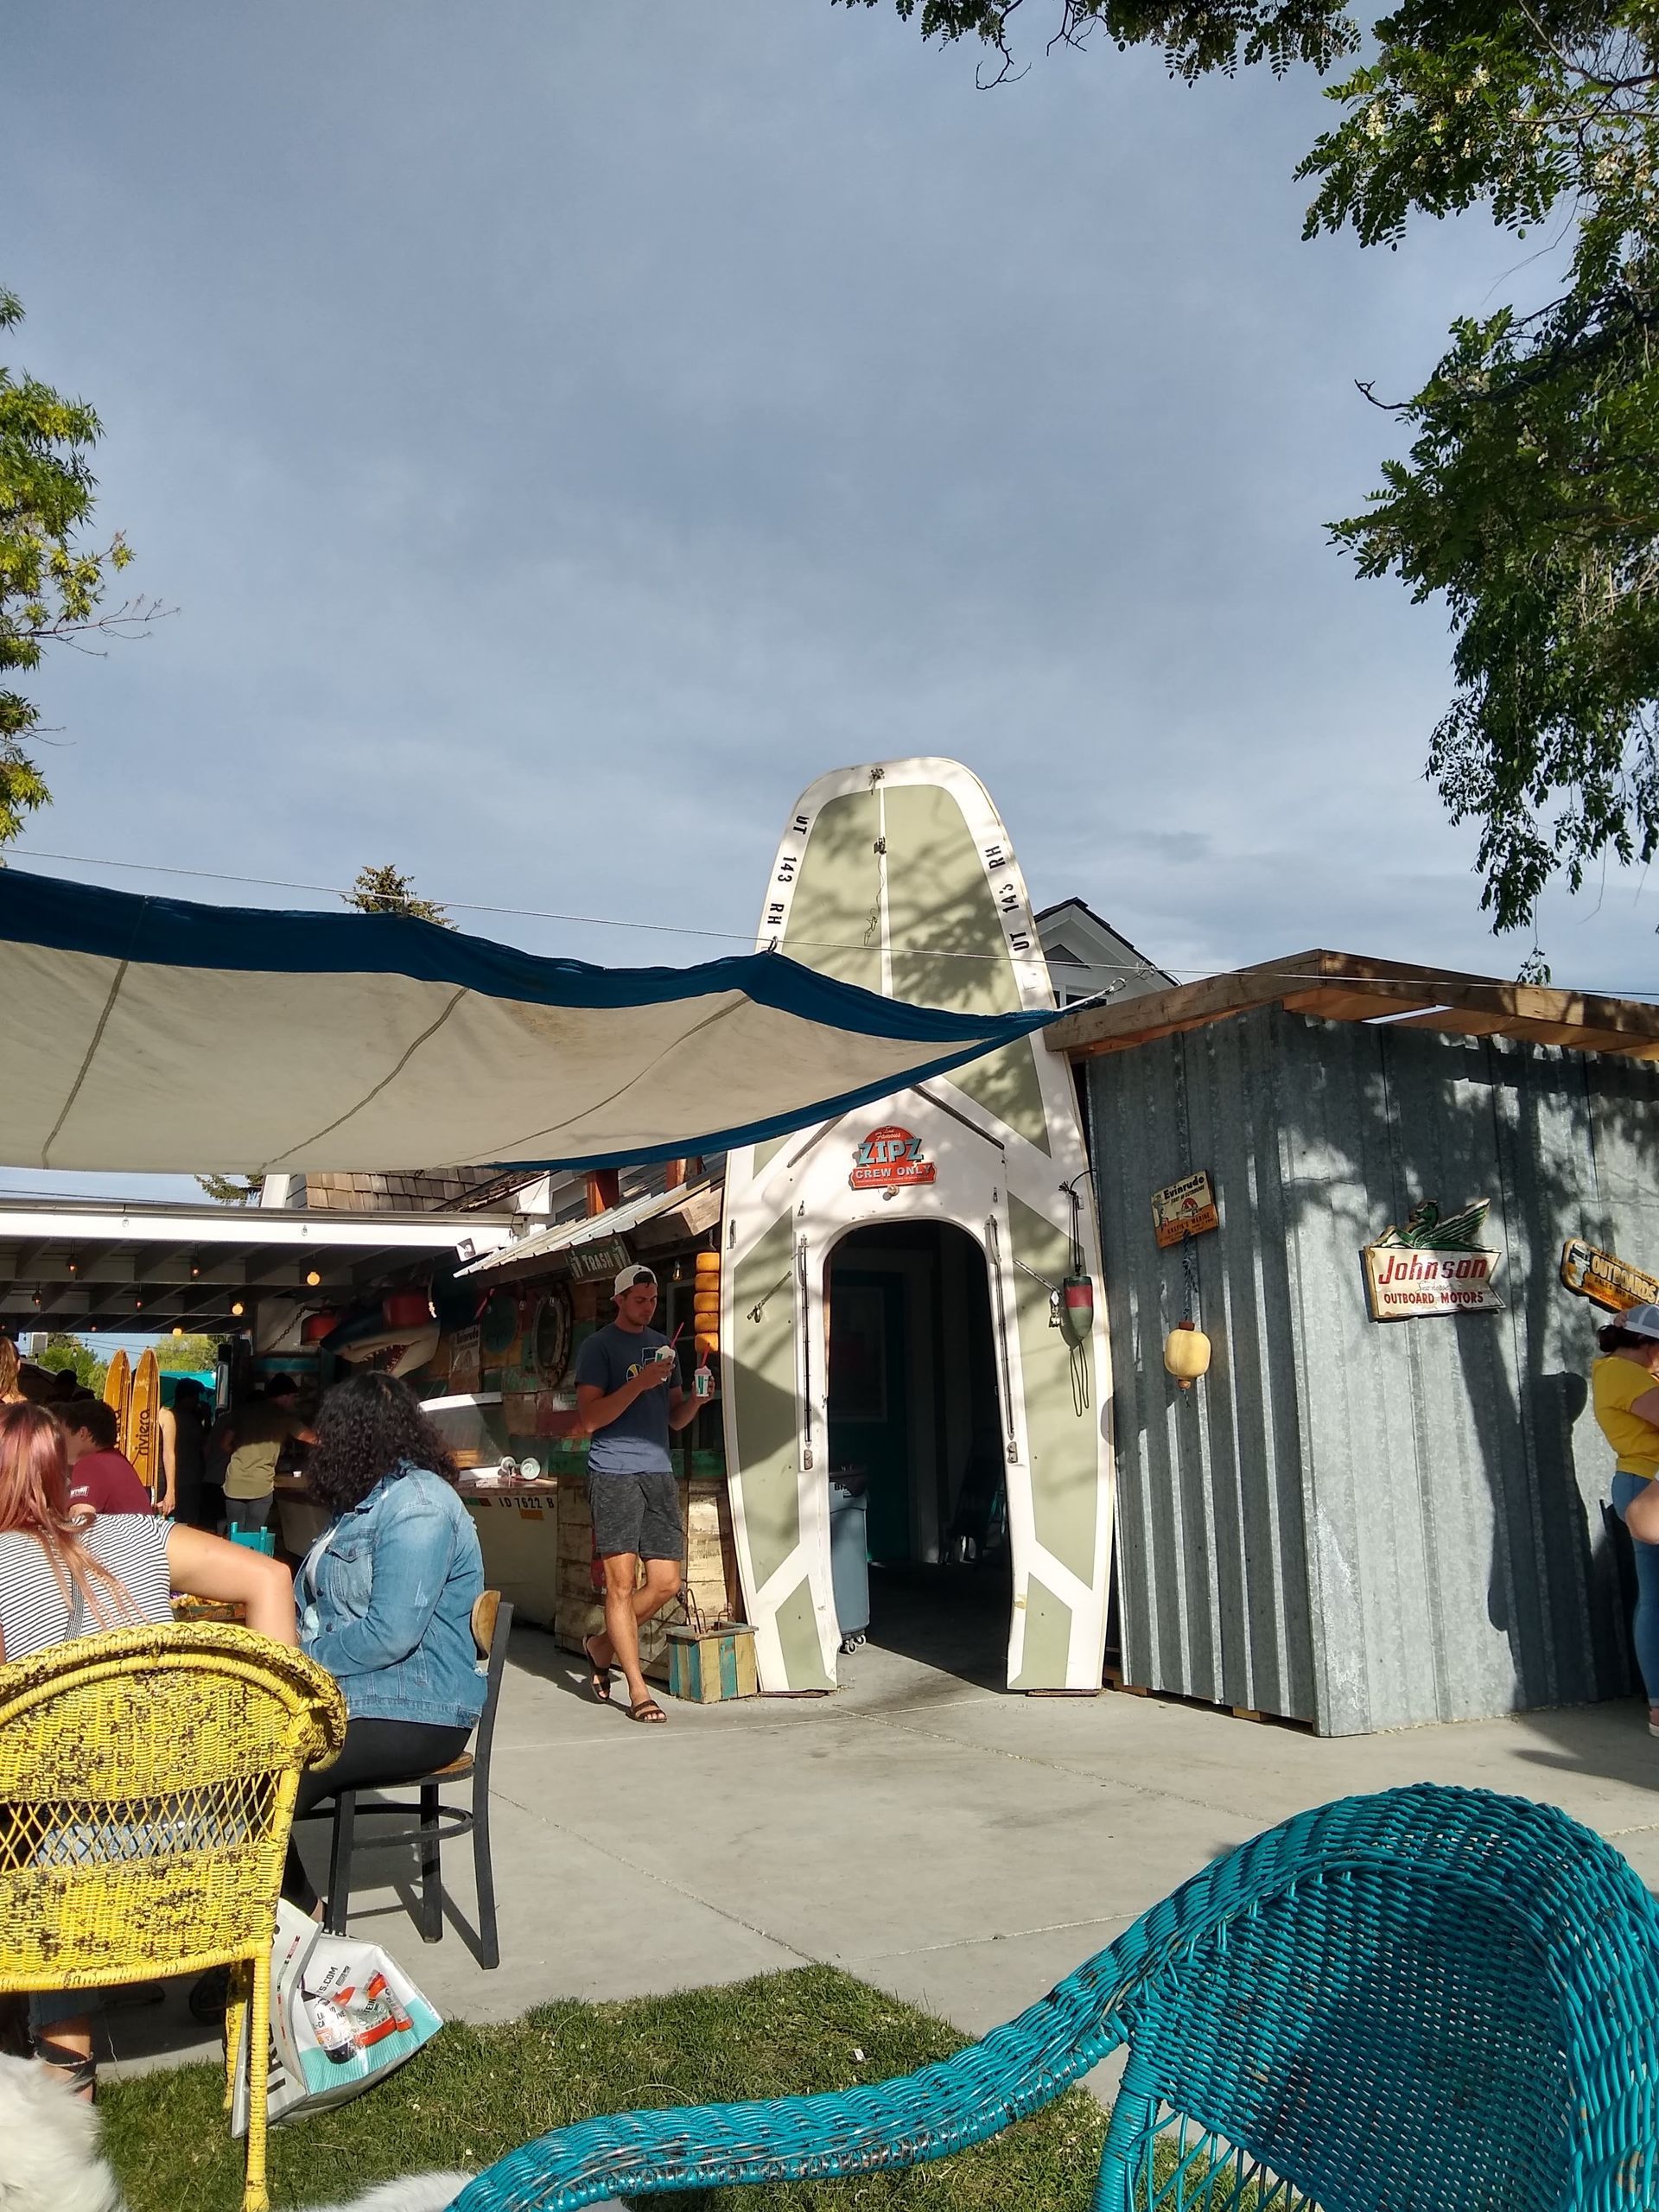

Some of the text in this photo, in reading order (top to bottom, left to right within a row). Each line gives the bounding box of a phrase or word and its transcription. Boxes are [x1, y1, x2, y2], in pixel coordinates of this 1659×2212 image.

[767, 815, 810, 925] UT 143 RH
[985, 845, 1030, 951] UT 143 RH
[858, 1138, 923, 1164] ZIPZ
[855, 1164, 931, 1179] CREW ONLY
[1163, 1175, 1205, 1200] Evinrude
[581, 1251, 614, 1272] TRASH
[1378, 1255, 1487, 1285] Johnson
[1592, 1255, 1656, 1304] OUTBOARDS
[1384, 1291, 1484, 1304] OUTBOARD MOTORS
[499, 1497, 555, 1509] ID 7622 B
